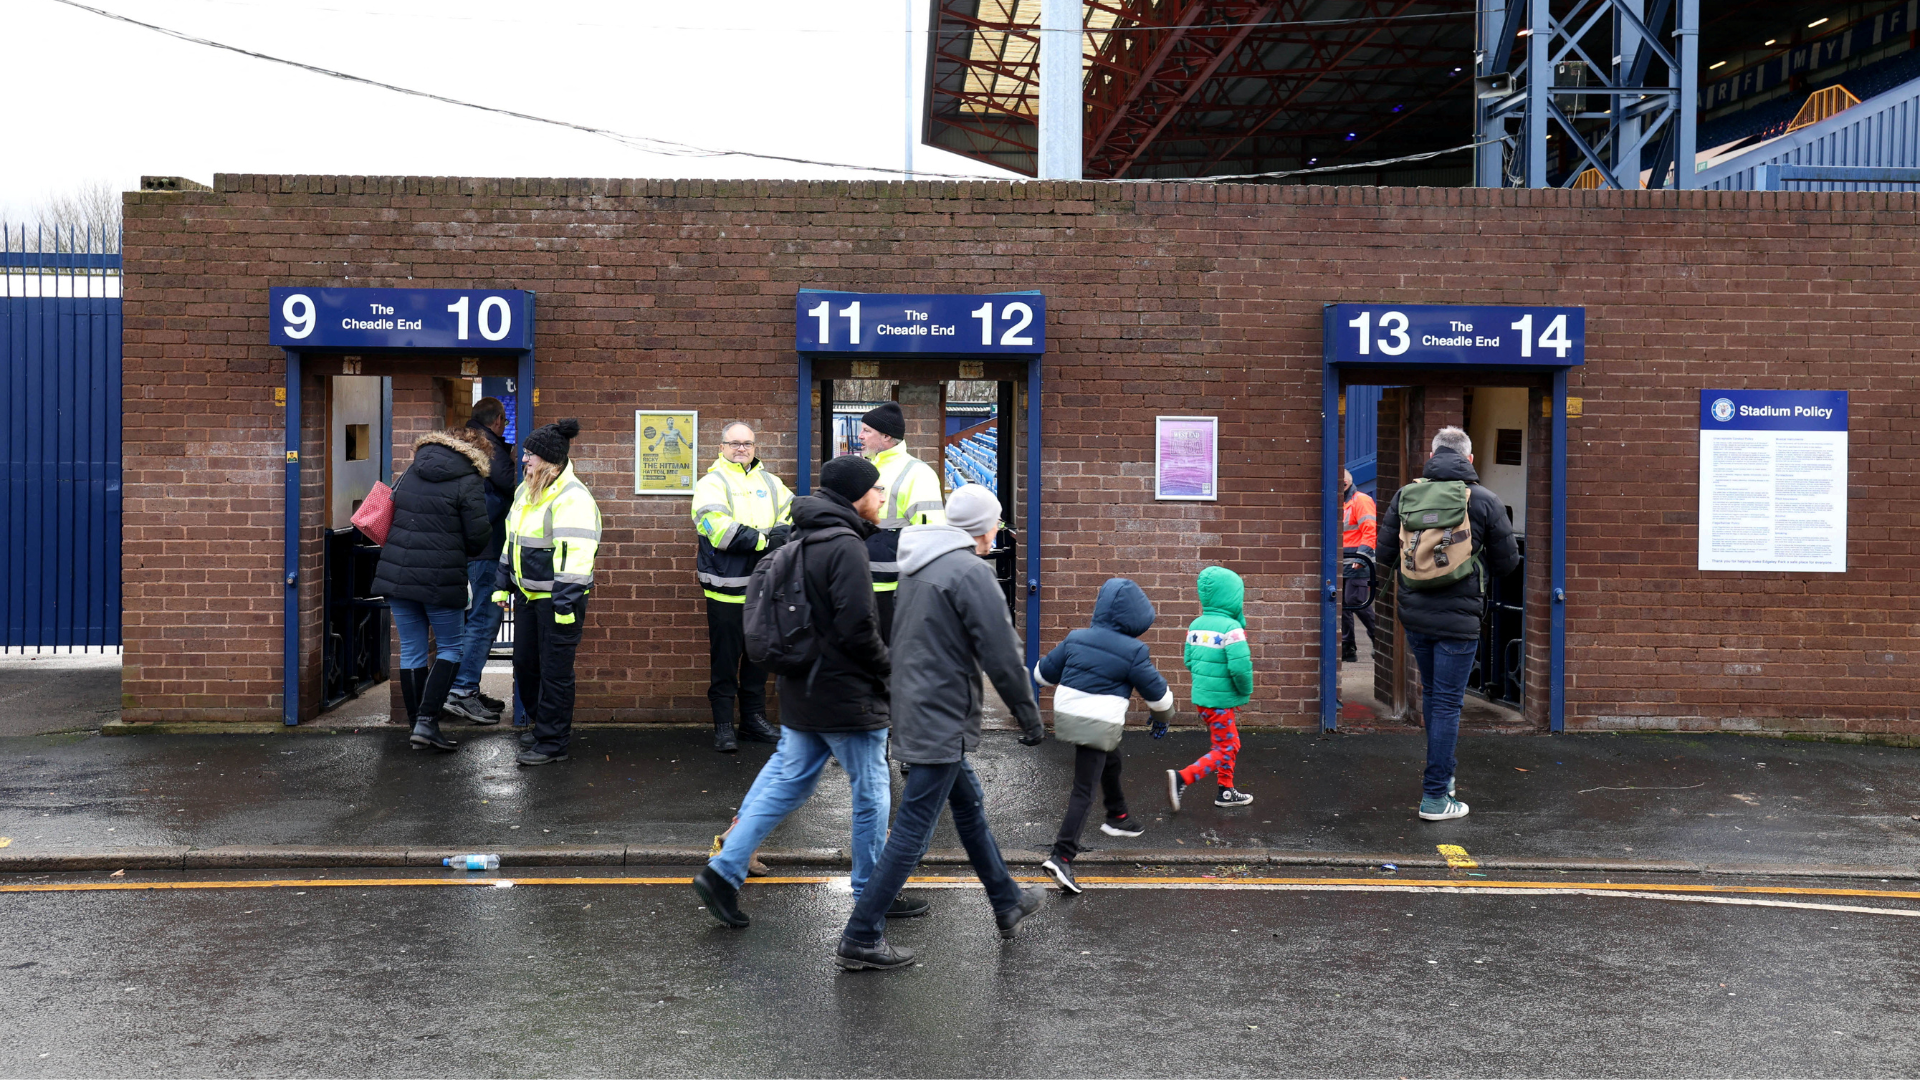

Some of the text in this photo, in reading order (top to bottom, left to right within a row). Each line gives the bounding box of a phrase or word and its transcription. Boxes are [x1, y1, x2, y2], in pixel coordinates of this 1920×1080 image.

[282, 293, 317, 340] 9
[369, 303, 395, 316] The
[904, 309, 929, 322] The
[342, 318, 422, 330] Cheadle End
[447, 296, 512, 341] 10
[808, 301, 861, 345] 11
[971, 302, 1033, 346] 12
[1449, 320, 1474, 333] The
[876, 324, 955, 336] Cheadle End
[1348, 311, 1411, 356] 13
[1511, 314, 1572, 358] 14
[1422, 335, 1500, 347] Cheadle End
[1739, 405, 1791, 418] Stadium
[1794, 405, 1833, 421] Policy
